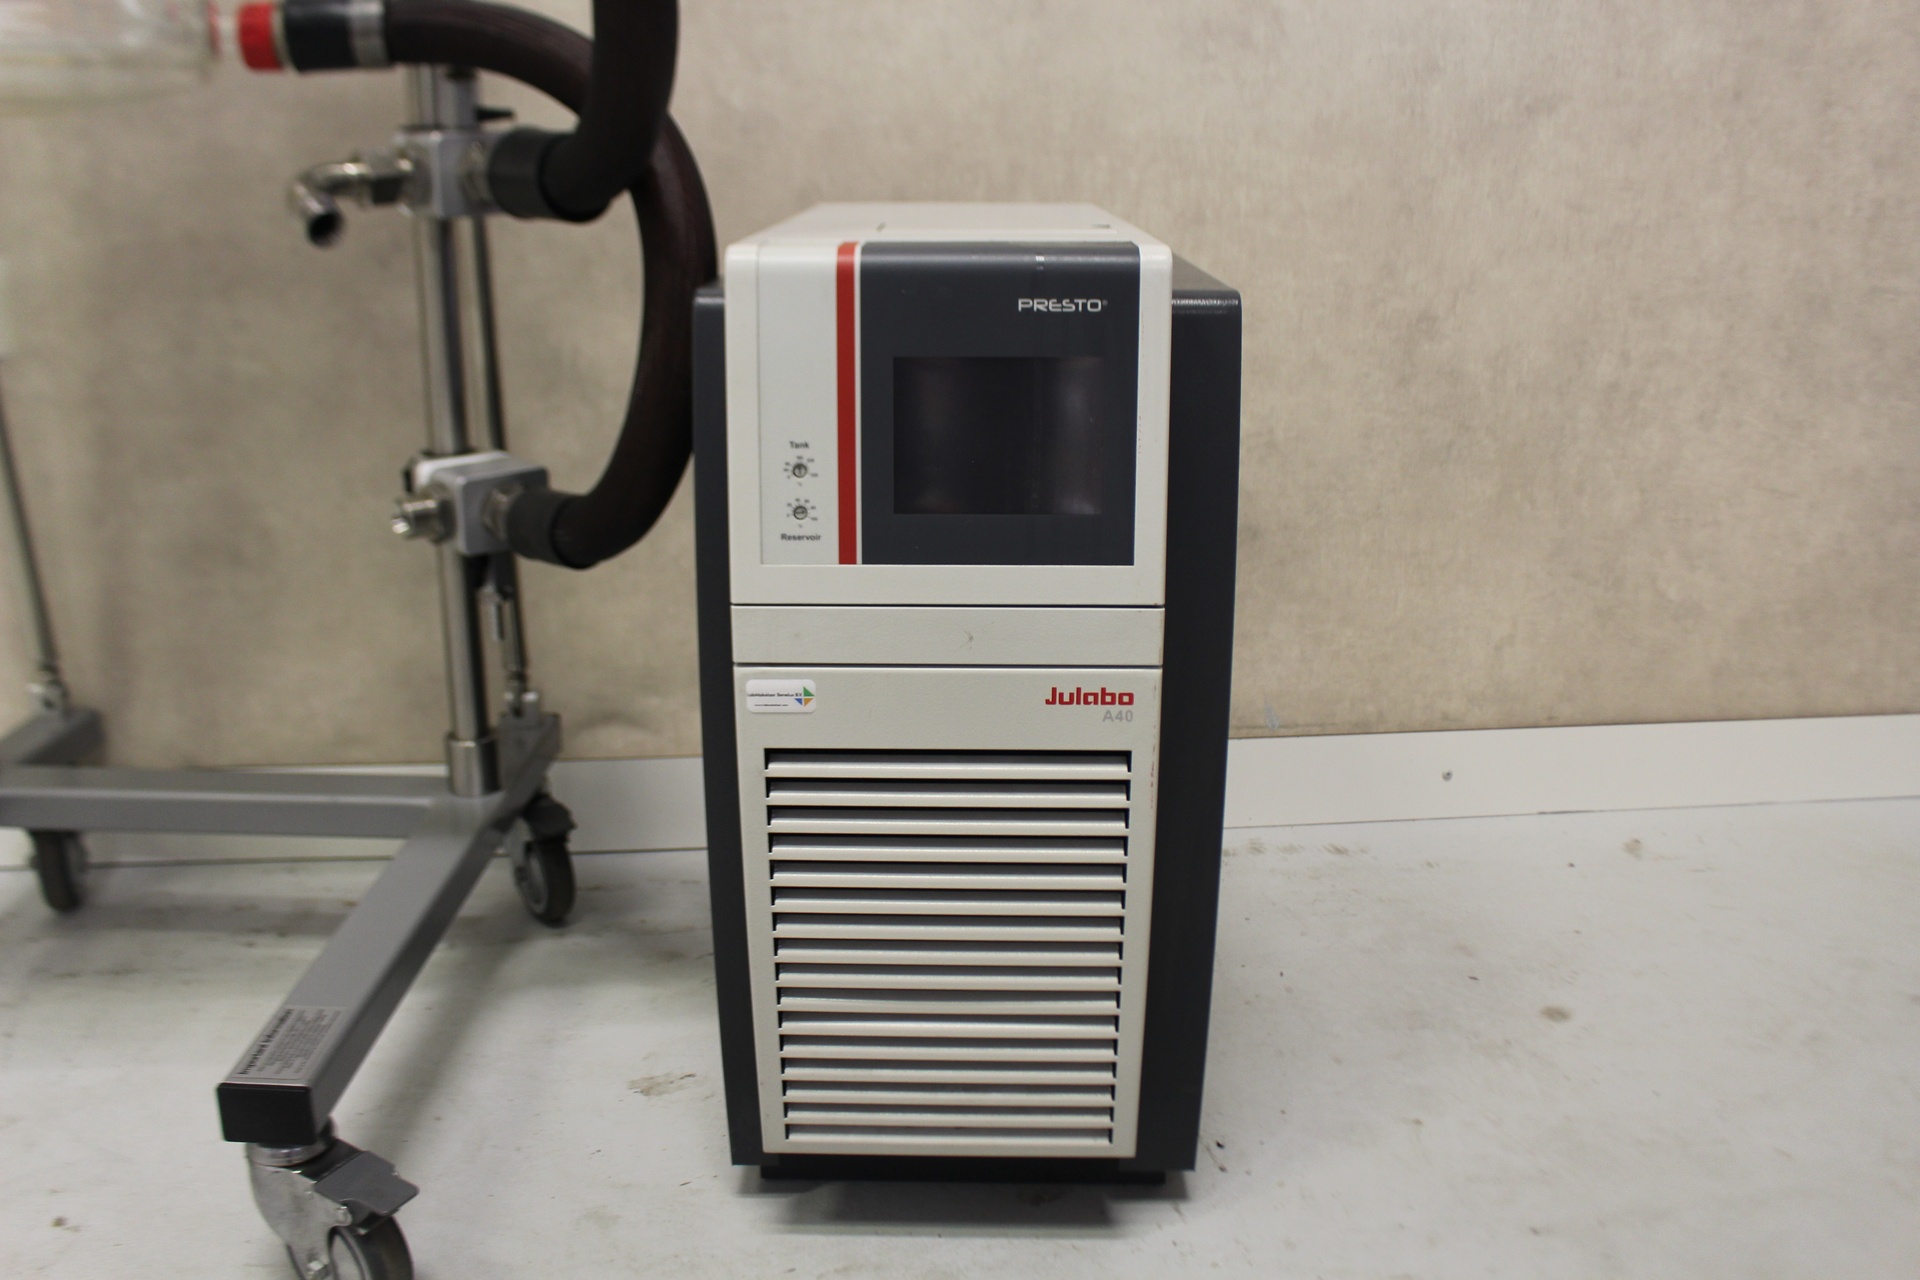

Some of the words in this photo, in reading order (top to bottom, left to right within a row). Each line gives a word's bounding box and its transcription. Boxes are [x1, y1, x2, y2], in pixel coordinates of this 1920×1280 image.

[789, 441, 810, 449] Tank
[781, 533, 821, 541] Reservoir
[1045, 687, 1134, 706] Julabo
[1103, 710, 1134, 722] A40
